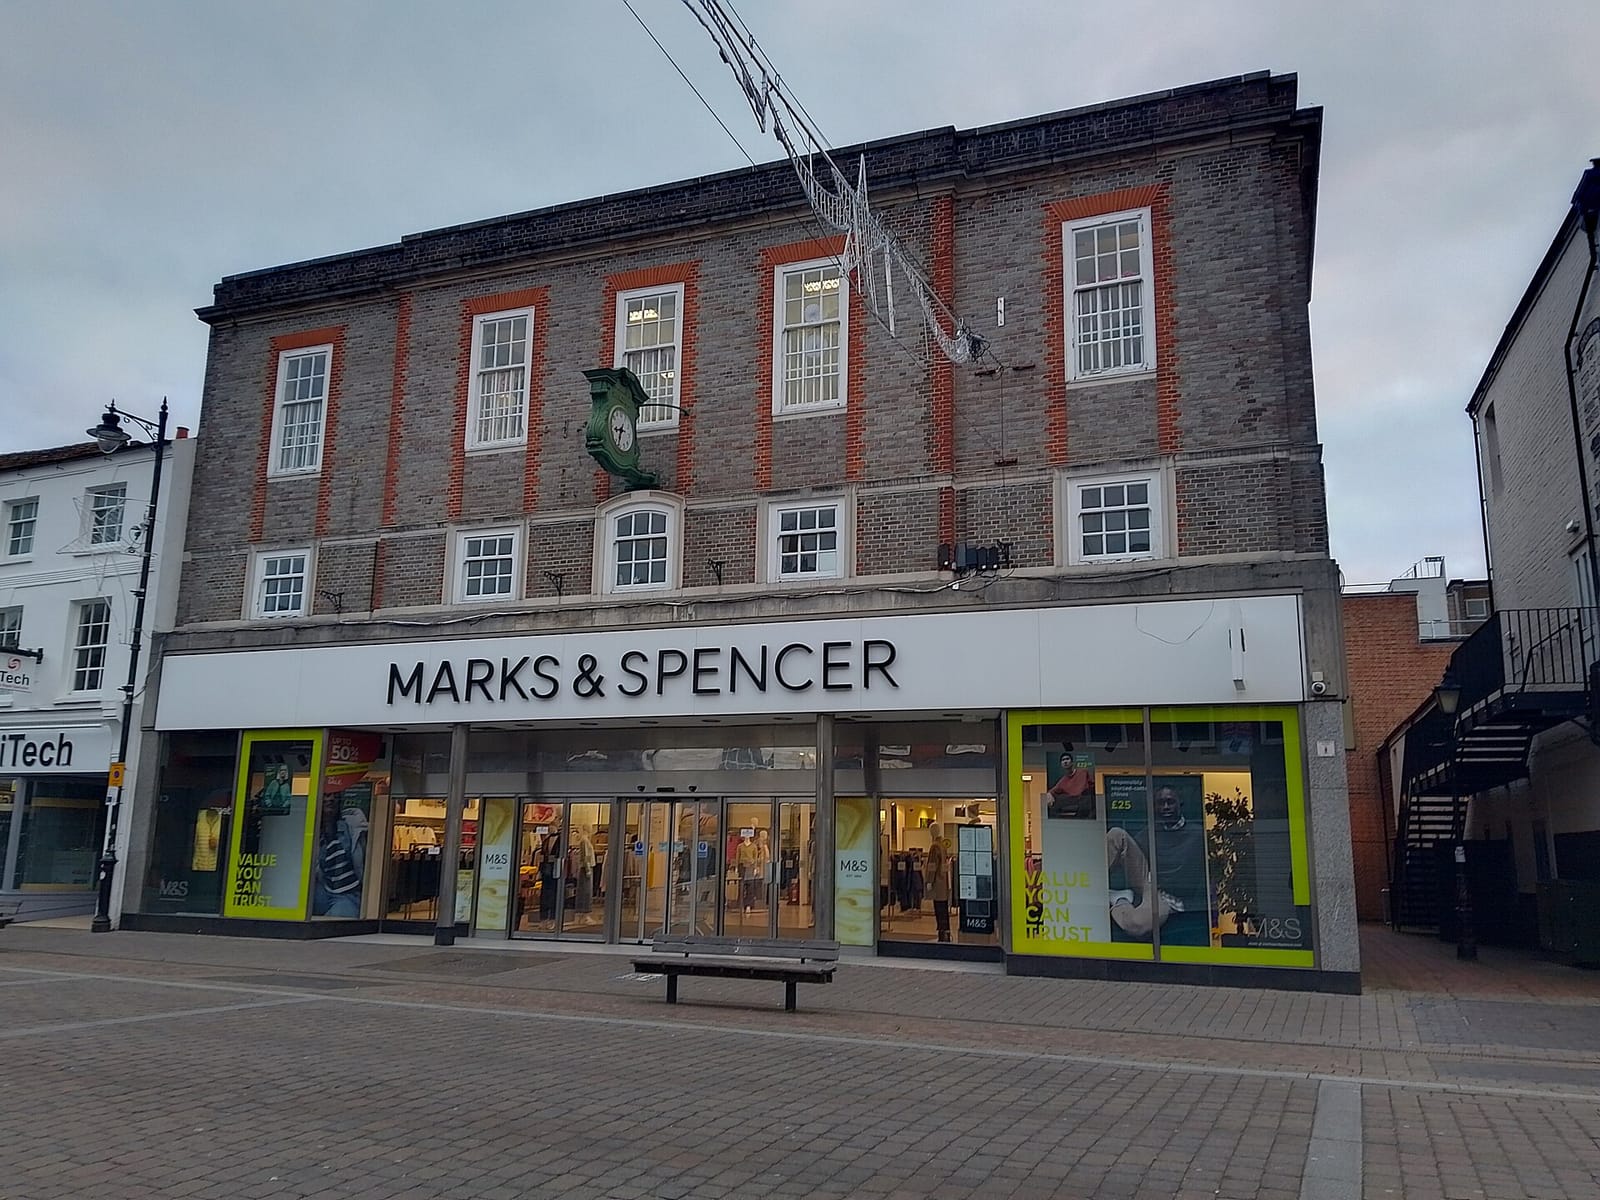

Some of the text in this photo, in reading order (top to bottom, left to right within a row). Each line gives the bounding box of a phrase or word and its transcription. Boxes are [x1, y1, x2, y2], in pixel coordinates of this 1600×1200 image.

[386, 639, 900, 705] MARKS & SPENCER
[1111, 800, 1132, 810] £25
[238, 853, 278, 867] VALUE
[484, 853, 508, 865] M&S
[840, 859, 868, 872] M&S
[236, 866, 264, 880] YOU
[1025, 871, 1090, 888] VALUE
[159, 879, 189, 897] M&S
[235, 880, 262, 895] CAN
[232, 894, 273, 908] TRUST
[1025, 888, 1069, 906] YOU
[1026, 905, 1071, 923] CAN
[966, 918, 987, 928] M&S
[1247, 917, 1302, 940] M&S
[1026, 923, 1094, 943] TRUST
